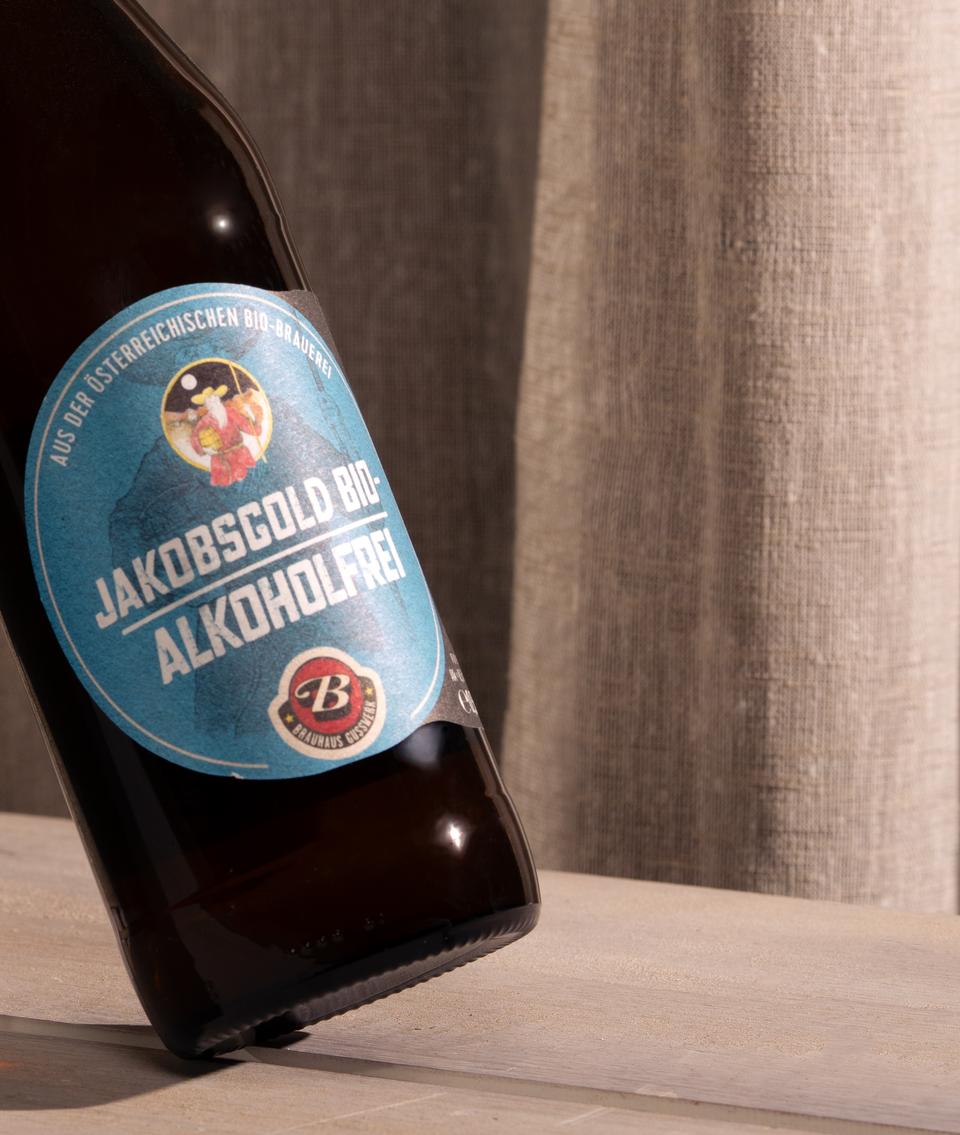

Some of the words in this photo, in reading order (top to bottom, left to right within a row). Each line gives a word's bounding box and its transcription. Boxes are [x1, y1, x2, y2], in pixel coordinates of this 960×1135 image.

[49, 429, 76, 467] AUS
[64, 390, 96, 427] DER
[83, 307, 241, 393] ÖSTERREICHISCHEN
[243, 307, 332, 379] BIO-BRAUEREI
[95, 476, 333, 629] JAKOBSGOLD
[336, 459, 381, 513] BIO-
[153, 528, 407, 684] ALKOHOLFREI
[293, 724, 343, 748] BRAUHAUS
[345, 699, 377, 745] GUSSWERK
[295, 674, 350, 712] B
